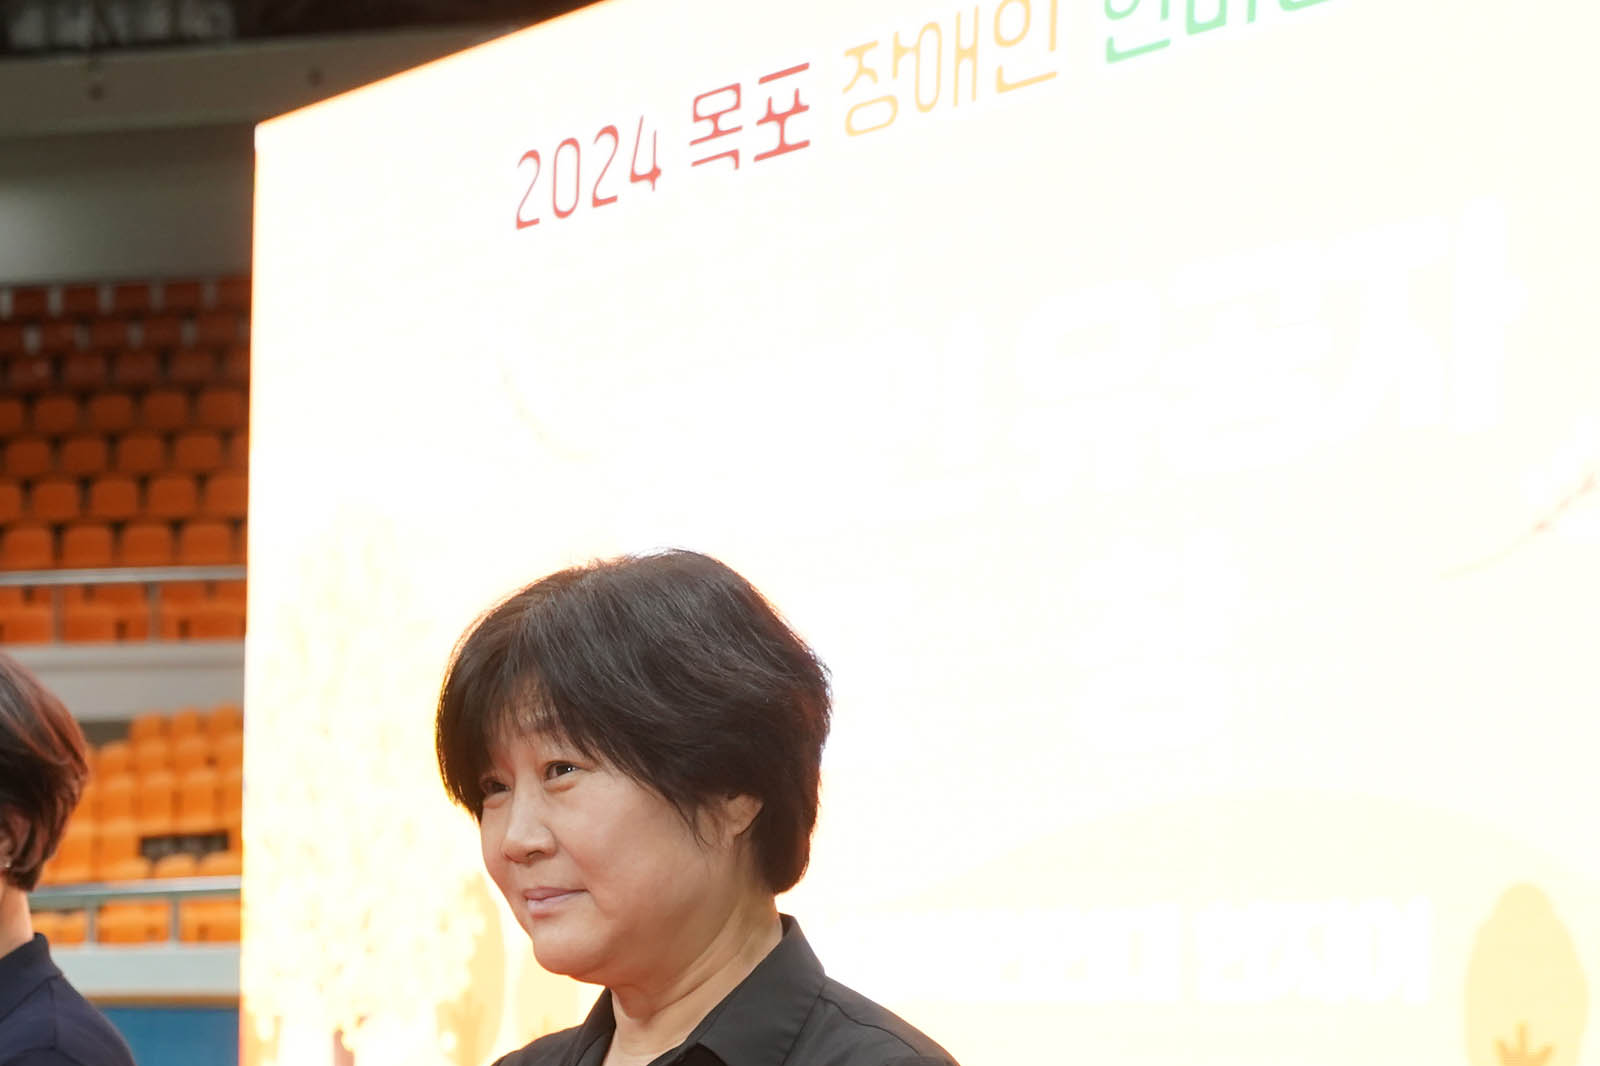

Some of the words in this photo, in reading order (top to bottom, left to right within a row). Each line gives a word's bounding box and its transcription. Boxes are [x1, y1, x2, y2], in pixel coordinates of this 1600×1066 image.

[516, 115, 662, 230] 2024
[688, 62, 811, 171] 목포
[842, 0, 1059, 137] 장애인
